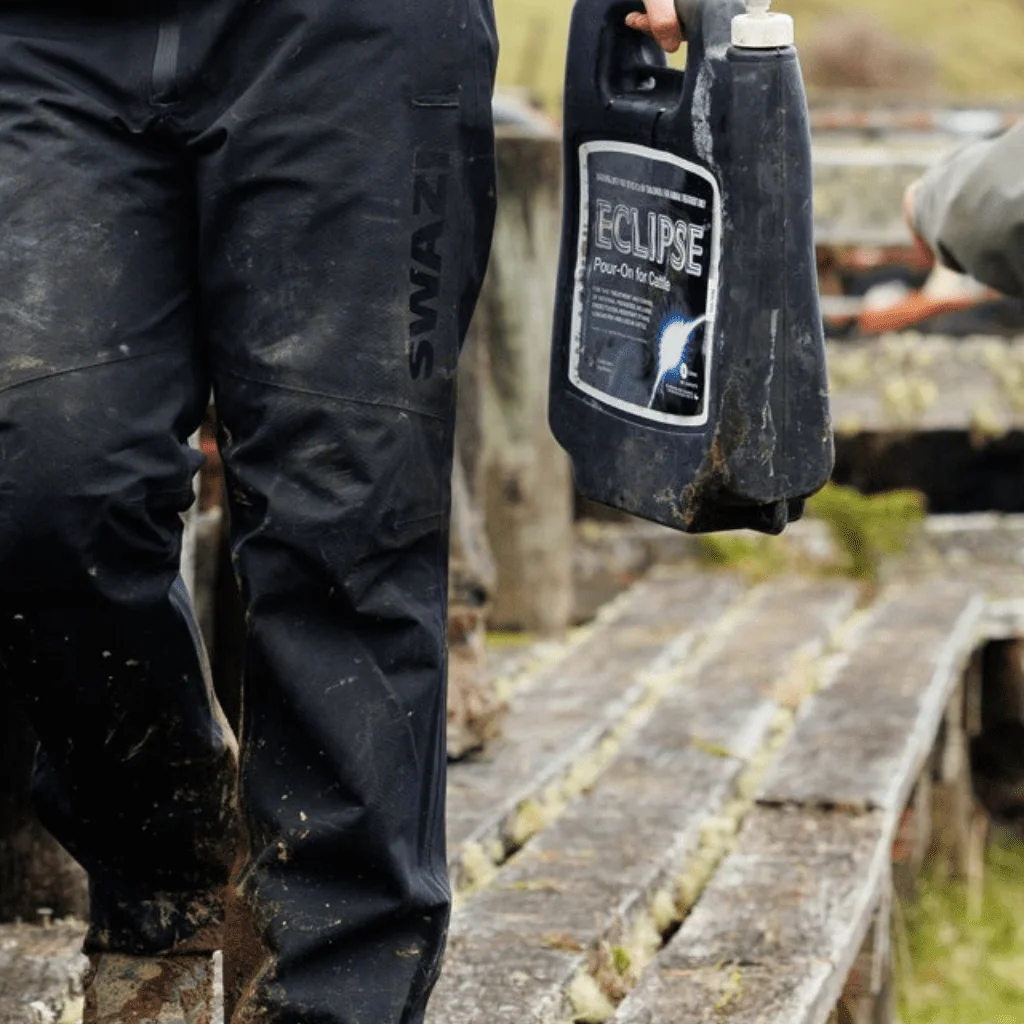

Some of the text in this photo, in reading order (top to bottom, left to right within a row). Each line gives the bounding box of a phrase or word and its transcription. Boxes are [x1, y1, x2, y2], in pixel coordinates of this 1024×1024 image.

[409, 150, 450, 380] SWAZI
[593, 256, 635, 280] Pour-On
[636, 267, 649, 283] for
[595, 199, 705, 277] ECLIPSE
